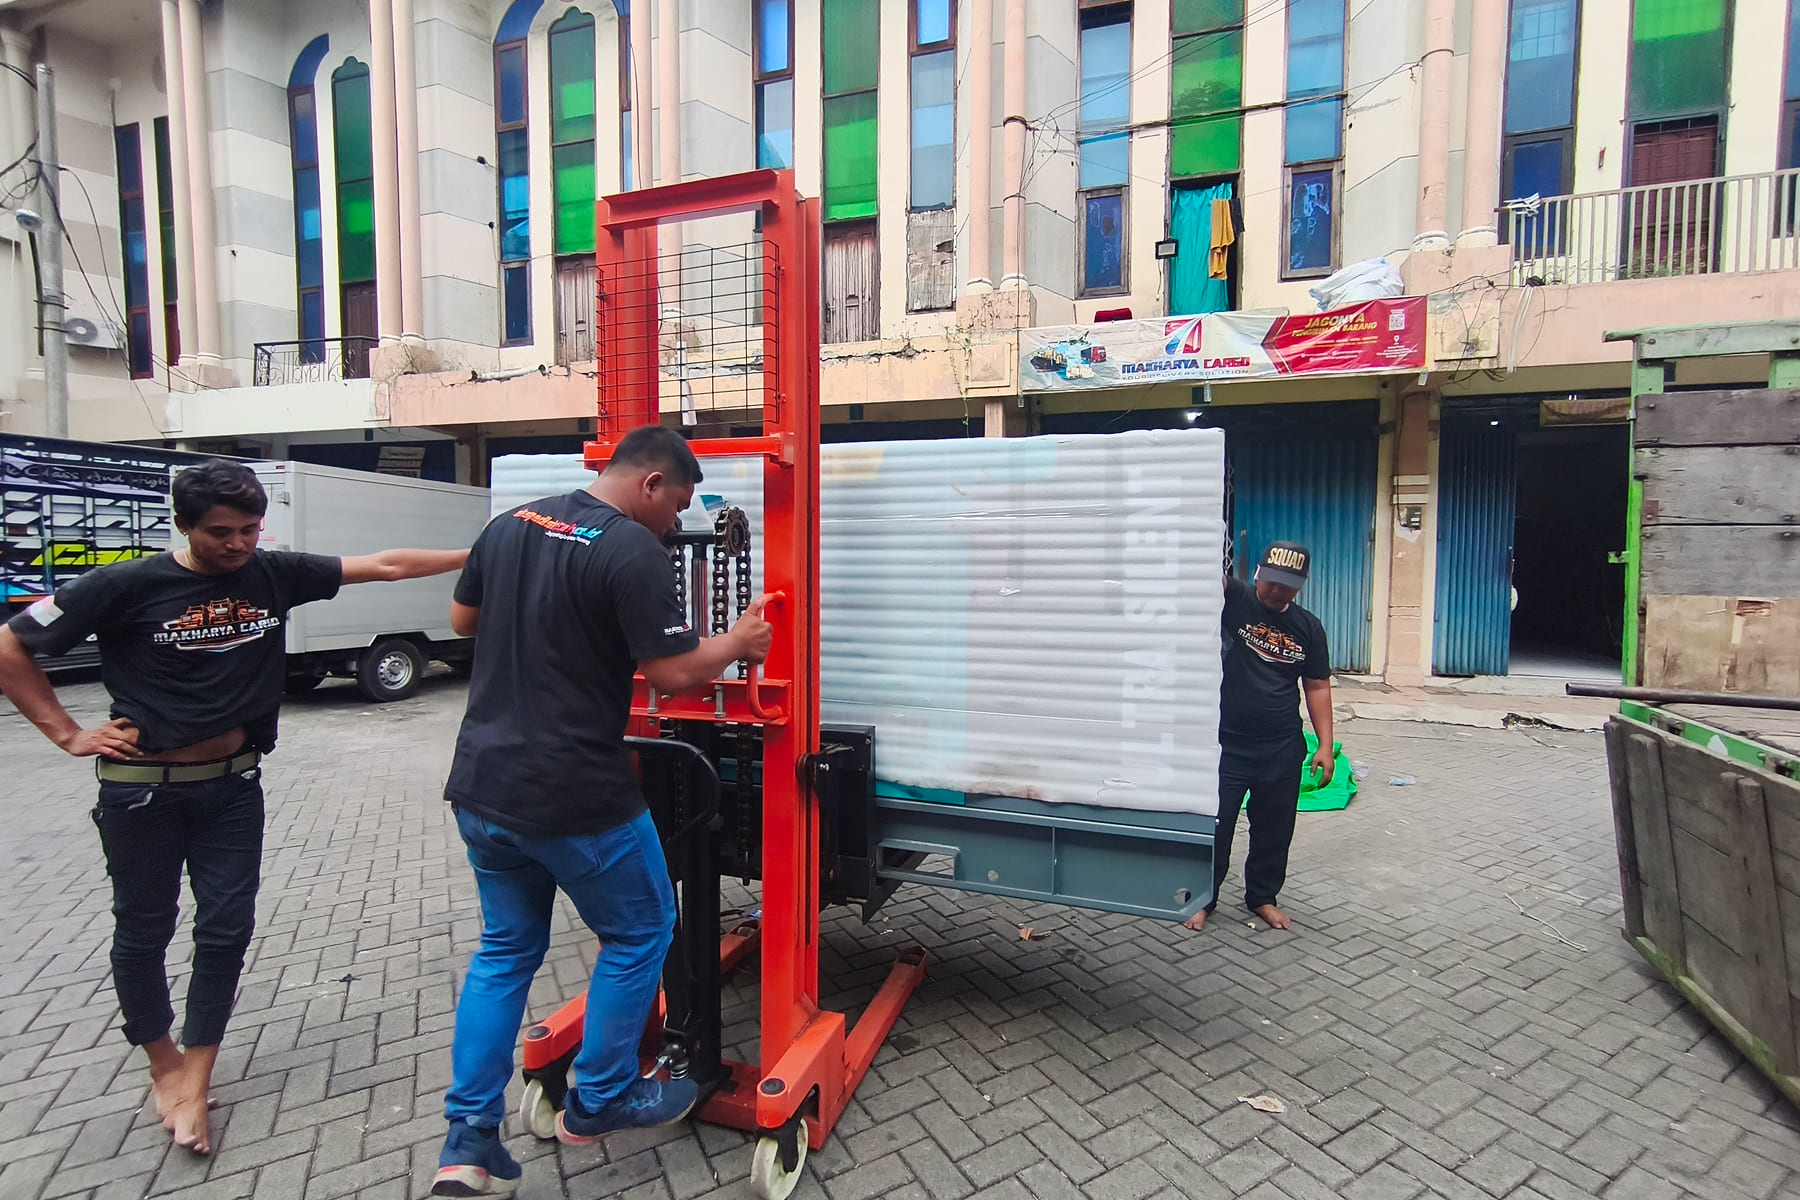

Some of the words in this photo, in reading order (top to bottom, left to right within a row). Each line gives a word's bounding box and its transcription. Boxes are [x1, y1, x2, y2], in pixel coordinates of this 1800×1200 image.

[1121, 359, 1200, 374] MAKHARYA
[1203, 356, 1251, 369] CARGO
[1122, 468, 1182, 625] SILENT
[1267, 547, 1306, 571] SQUAD
[153, 624, 236, 643] MAKHARYA
[1120, 647, 1177, 787] ULTRA
